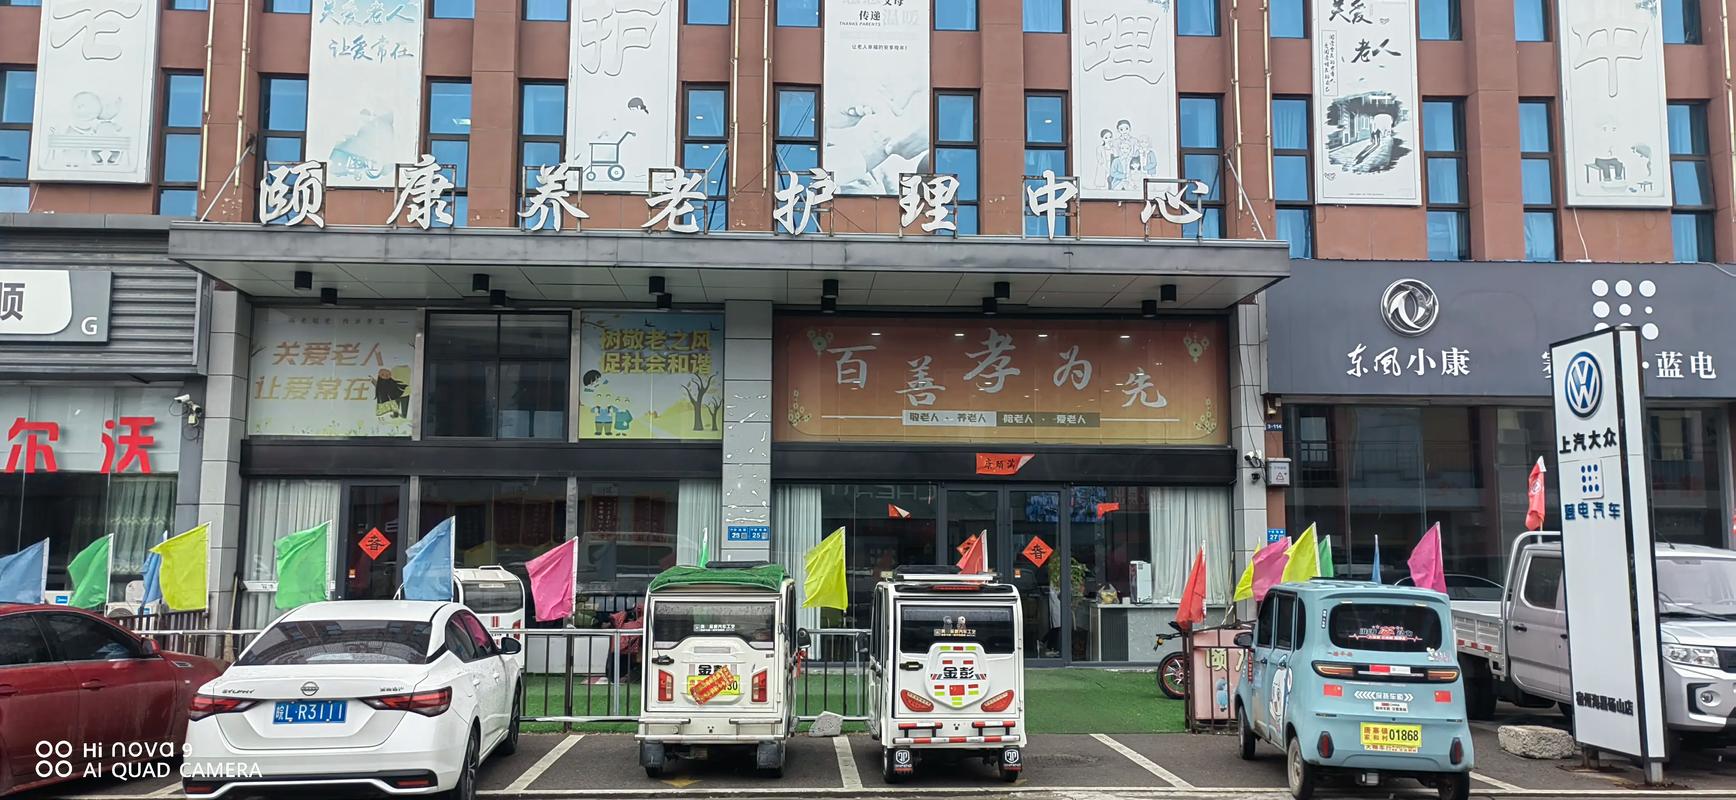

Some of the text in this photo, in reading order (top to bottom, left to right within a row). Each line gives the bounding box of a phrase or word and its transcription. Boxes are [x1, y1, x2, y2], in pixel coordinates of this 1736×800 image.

[1350, 38, 1402, 63] 老人
[259, 154, 1210, 240] 颐康养老护理中心
[80, 316, 98, 336] G
[601, 328, 712, 351] 树敬老之风
[272, 341, 385, 366] 关爱老人
[1346, 342, 1471, 378] 东风小康
[826, 327, 1168, 408] 百善孝为先
[254, 375, 372, 401] 让爱常在
[5, 416, 156, 474] 尔沃
[1559, 427, 1617, 454] 上汽大众
[943, 666, 975, 679] 金彭
[1389, 729, 1419, 742] 01868
